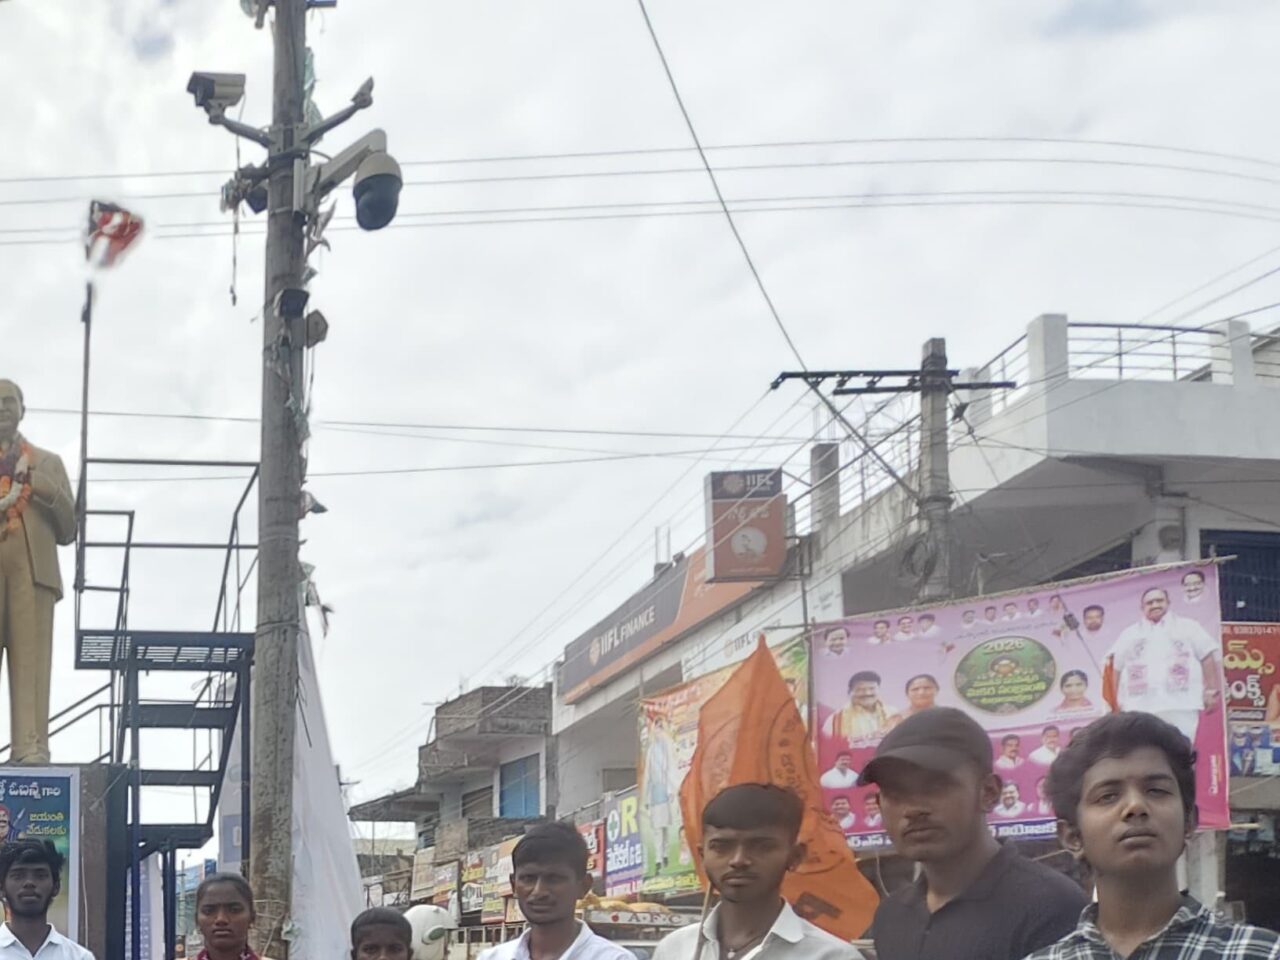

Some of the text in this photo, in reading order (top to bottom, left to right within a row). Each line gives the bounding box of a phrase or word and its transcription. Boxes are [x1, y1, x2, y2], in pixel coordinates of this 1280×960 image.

[600, 605, 656, 656] IIFL FINANCE
[983, 639, 1025, 655] 2026
[29, 811, 65, 823] జయంతి
[26, 823, 68, 837] వేడుకలకు
